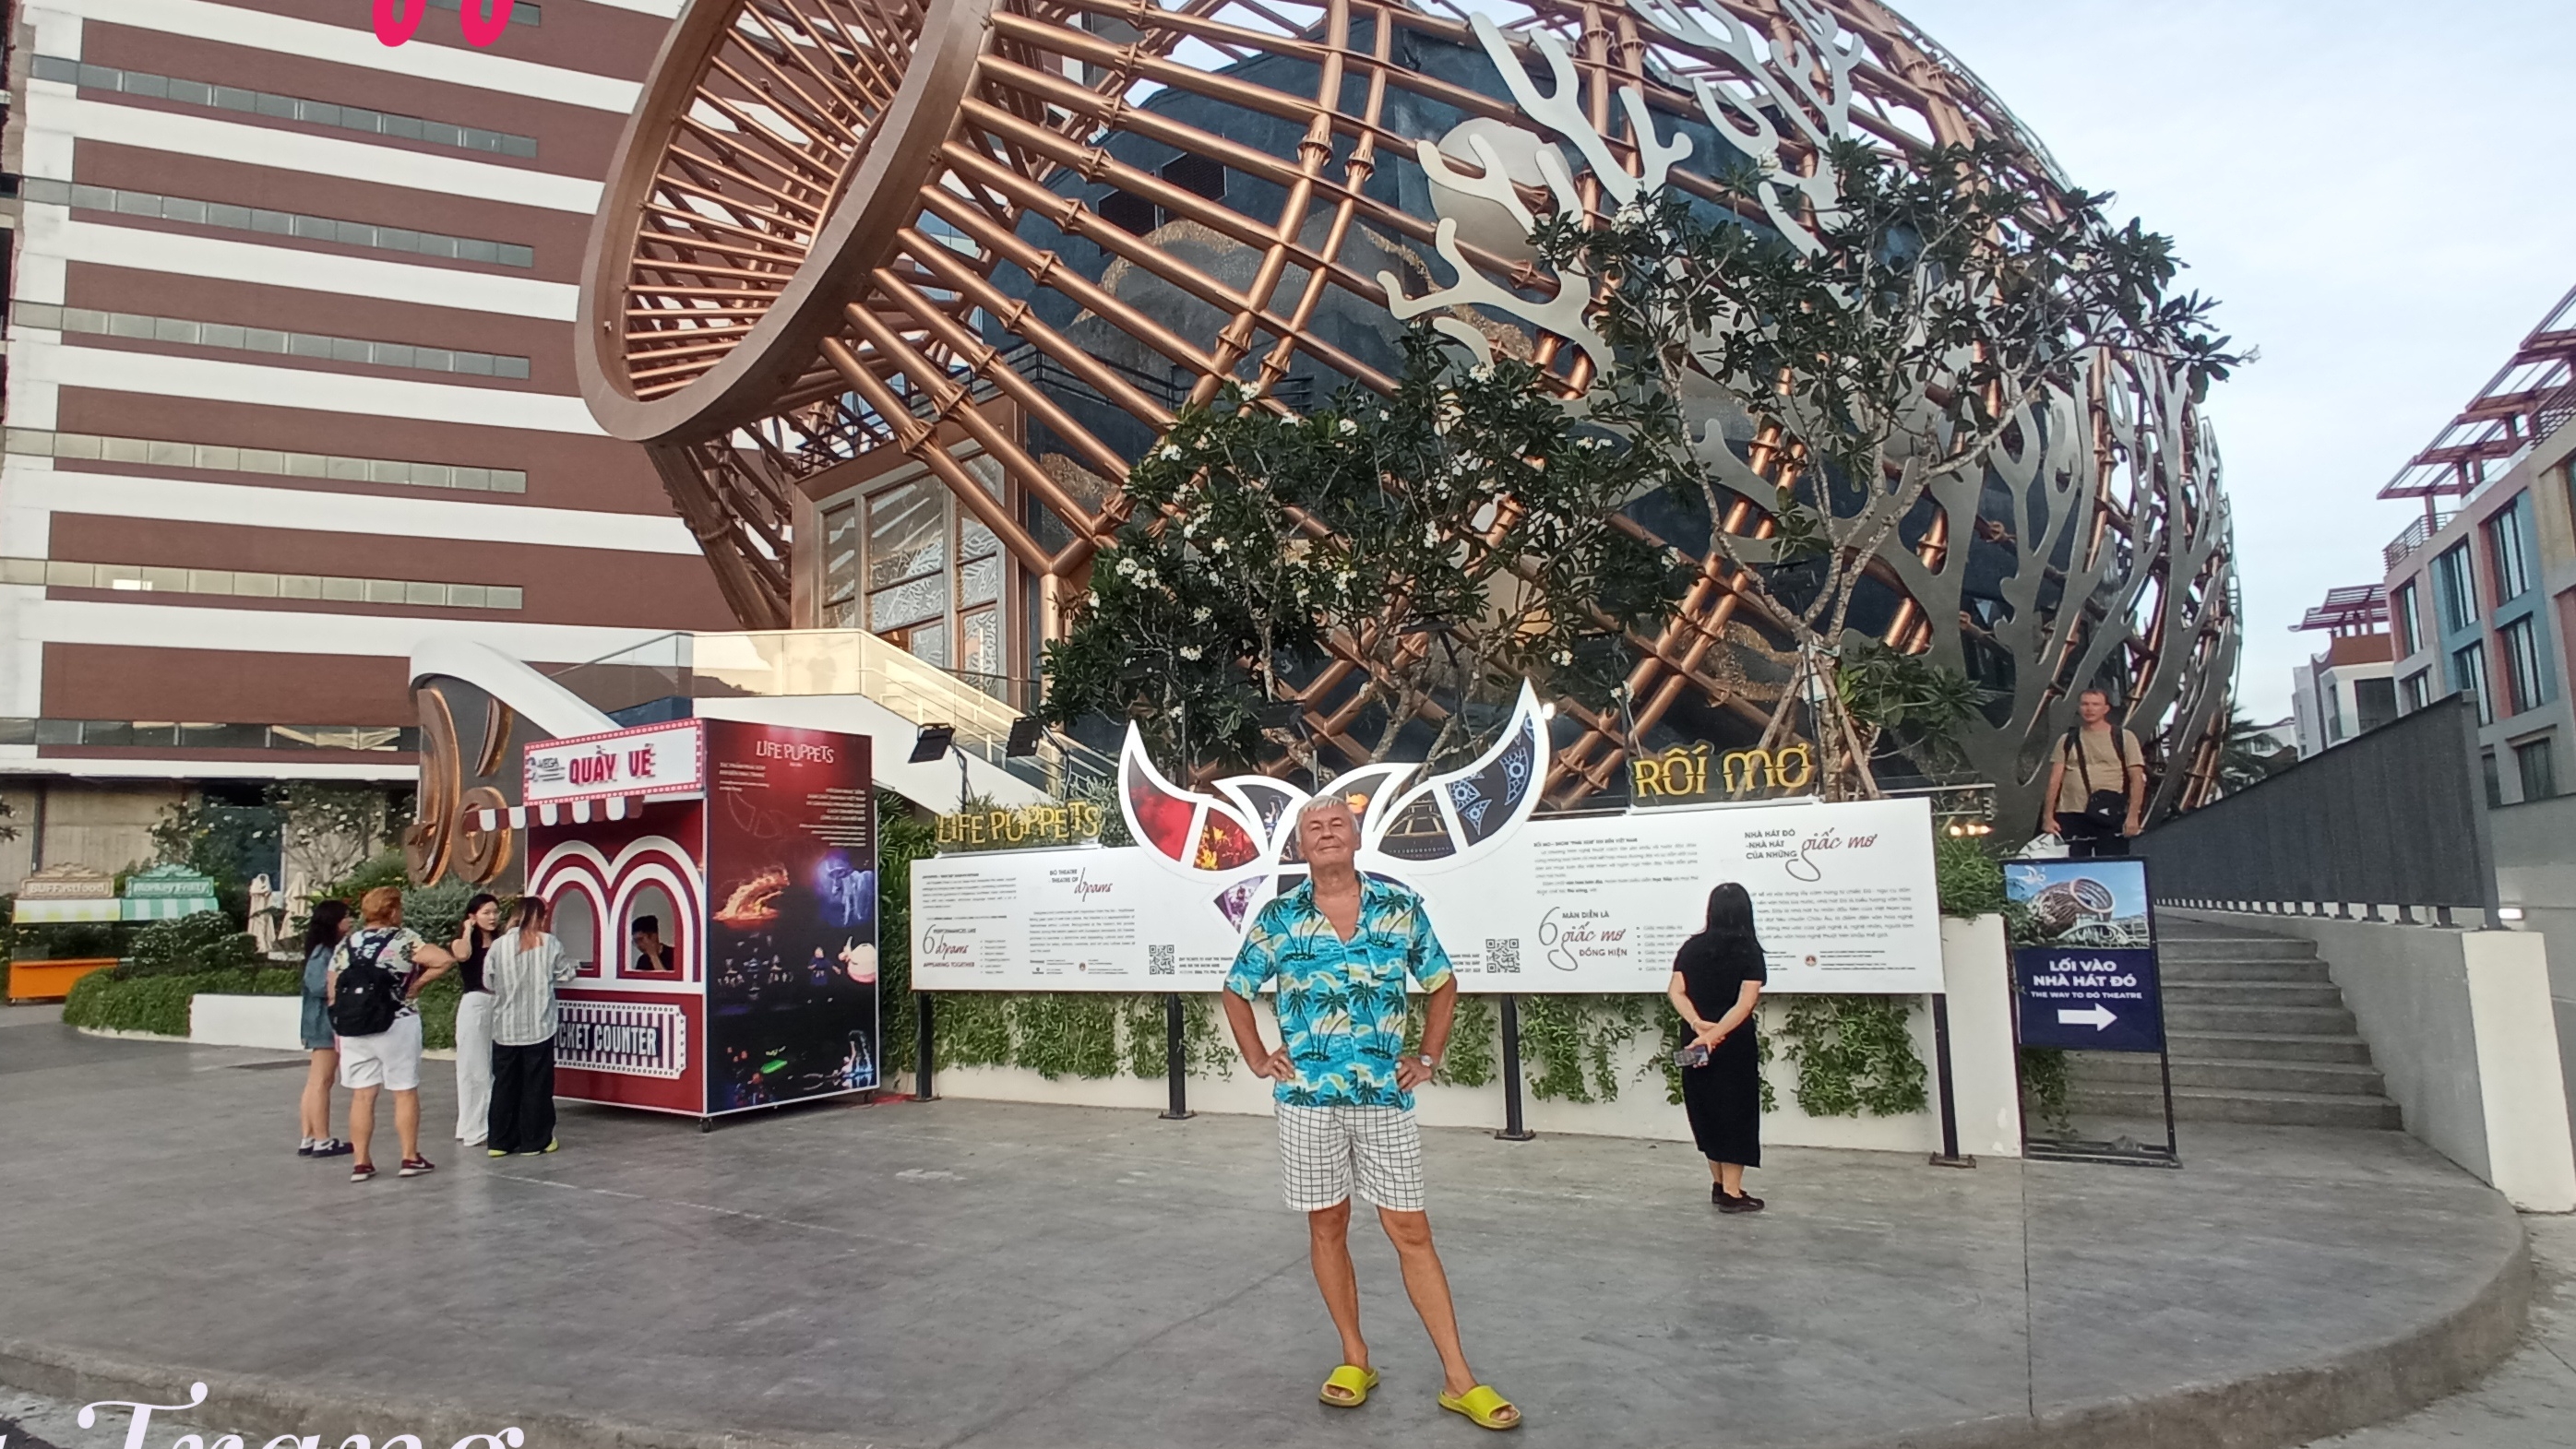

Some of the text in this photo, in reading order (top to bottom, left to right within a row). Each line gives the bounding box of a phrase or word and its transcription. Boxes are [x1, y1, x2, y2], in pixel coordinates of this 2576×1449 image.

[756, 741, 835, 764] LIFE PUPPETS
[569, 744, 617, 786] QUẦY
[1633, 744, 1708, 799] RỐI
[936, 801, 1101, 844] LIFE PUPPETS
[1744, 830, 1763, 839] NHÀ
[1847, 833, 1878, 849] mơ
[1766, 849, 1797, 859] NHỮNG
[1538, 906, 1560, 946] 6
[1600, 928, 1627, 942] mơ
[2049, 957, 2117, 972] LỐI VÀO
[2033, 973, 2137, 987] NHÀ HÁT ĐÓ
[593, 1024, 657, 1056] COUNTER
